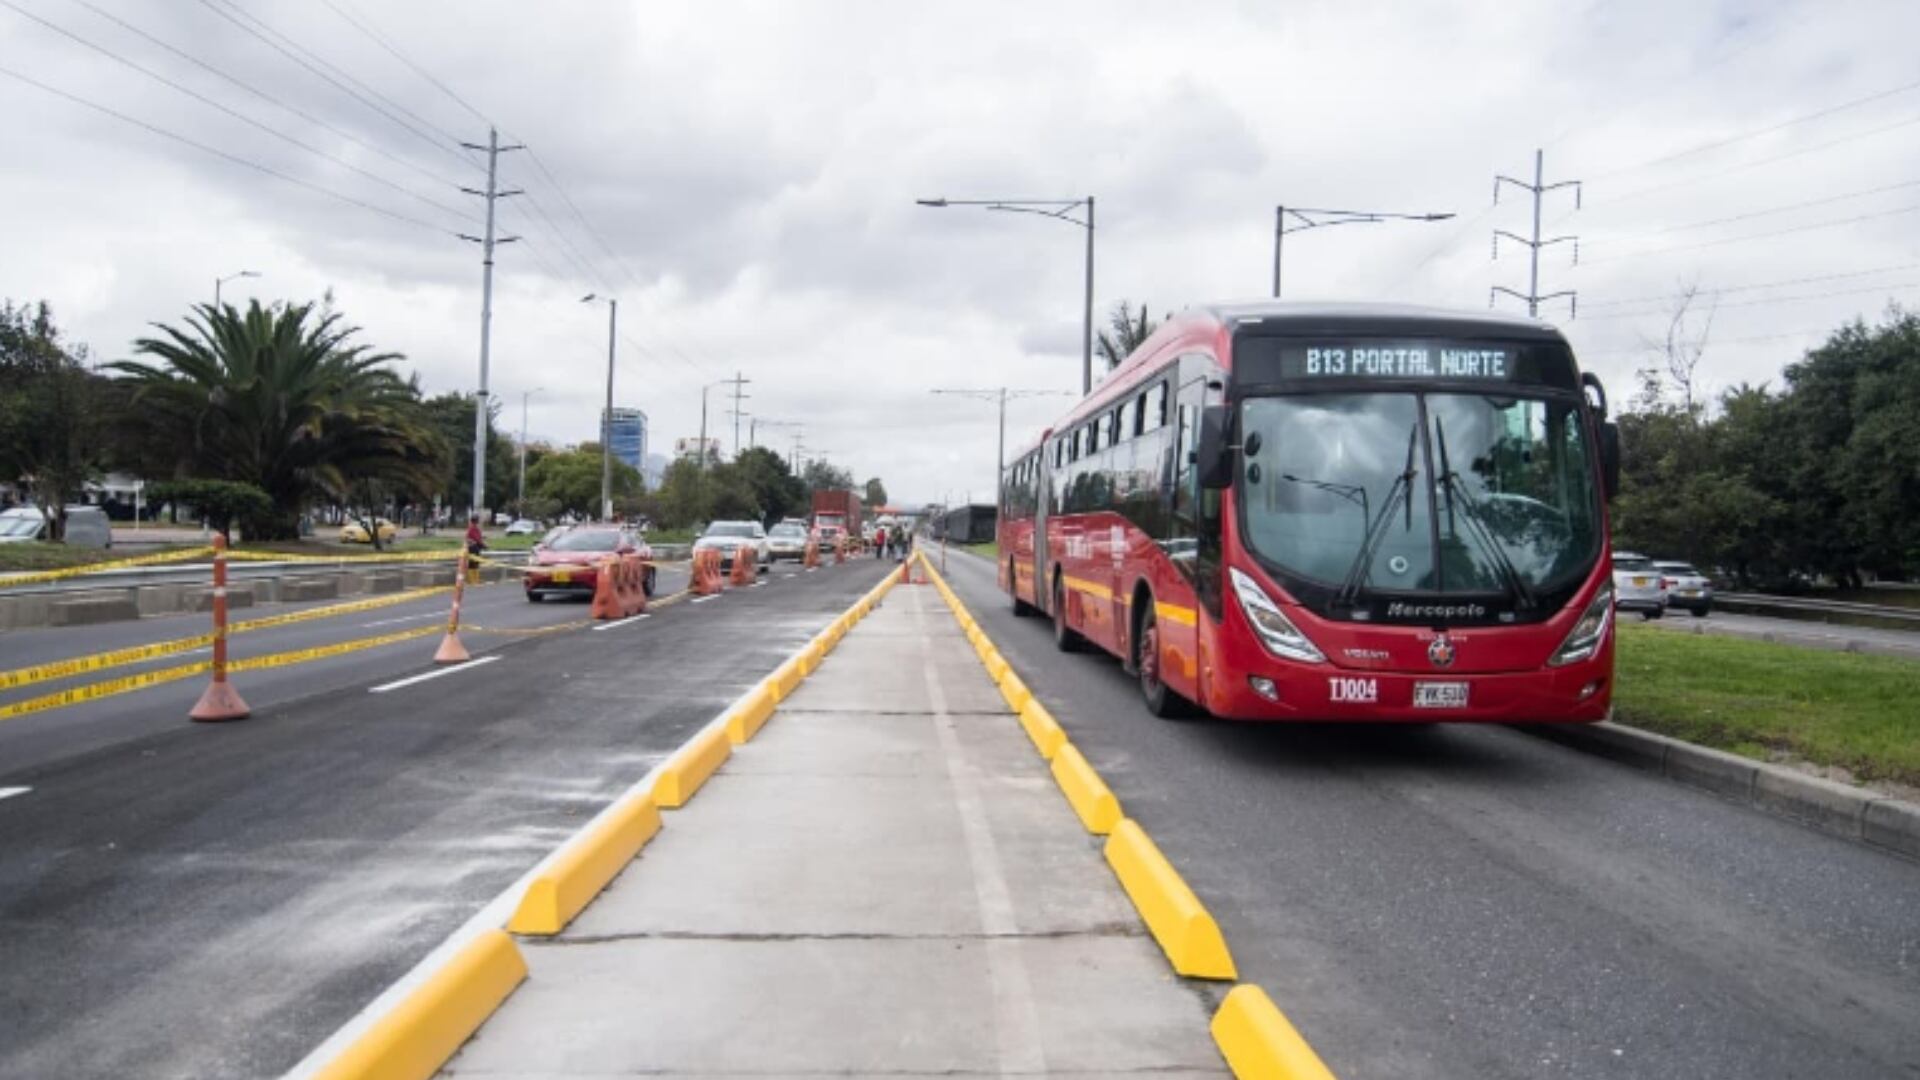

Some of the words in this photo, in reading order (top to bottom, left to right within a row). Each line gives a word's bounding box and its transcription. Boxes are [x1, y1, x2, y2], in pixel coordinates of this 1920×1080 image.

[1306, 348, 1346, 375] B13
[1351, 348, 1435, 376] PORTAL
[1440, 350, 1506, 377] NORTE
